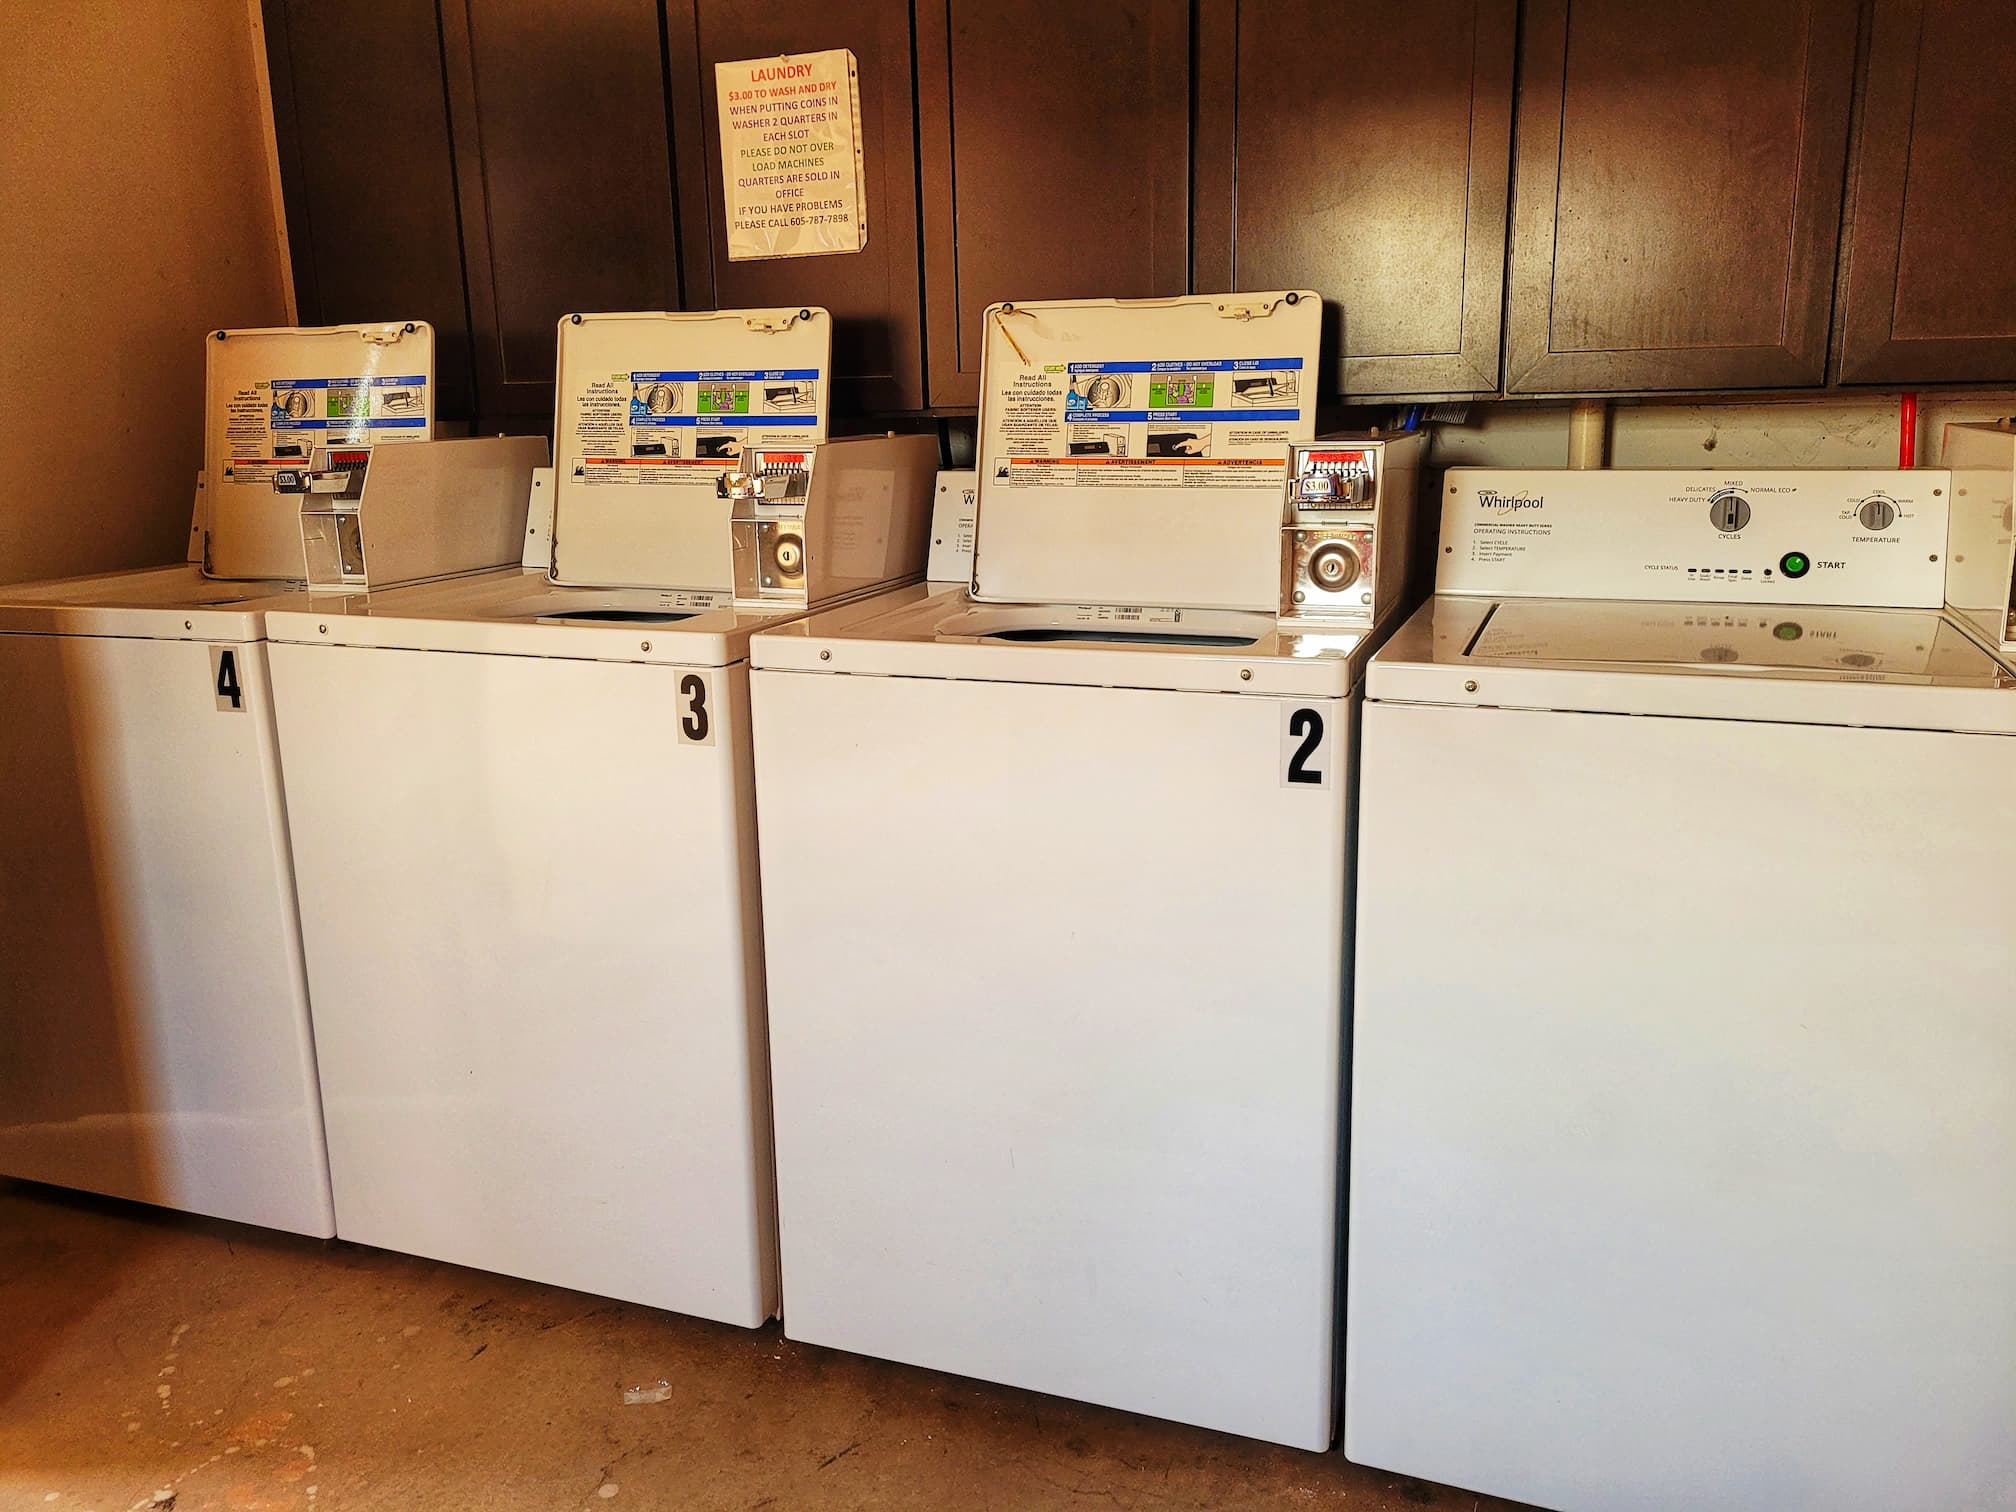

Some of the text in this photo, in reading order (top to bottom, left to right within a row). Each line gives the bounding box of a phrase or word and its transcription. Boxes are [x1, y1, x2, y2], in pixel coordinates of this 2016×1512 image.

[751, 64, 812, 83] LAUNDRY
[729, 81, 837, 101] $3.00 TO WASH AND DRY
[730, 96, 838, 116] WHEN PUTTING COINS IN
[733, 112, 838, 130] WASHER 2 QUARTERS IN
[763, 130, 809, 142] EACH SLOT
[741, 142, 834, 158] PLEASE DO NOT OVER
[752, 158, 824, 172] LOAD MACHINES
[738, 171, 840, 187] QUARTERS ARE SOLD IN
[776, 188, 804, 198] OFFICE
[739, 200, 842, 215] IF YOU HAVE PROBLEMS
[735, 214, 848, 230] PLEASE CALL 605-787-7898
[1305, 481, 1328, 491] $3.00
[1480, 496, 1543, 511] Whirlpool
[218, 651, 241, 708] 4
[681, 675, 708, 740] 3
[1288, 708, 1323, 784] 2
